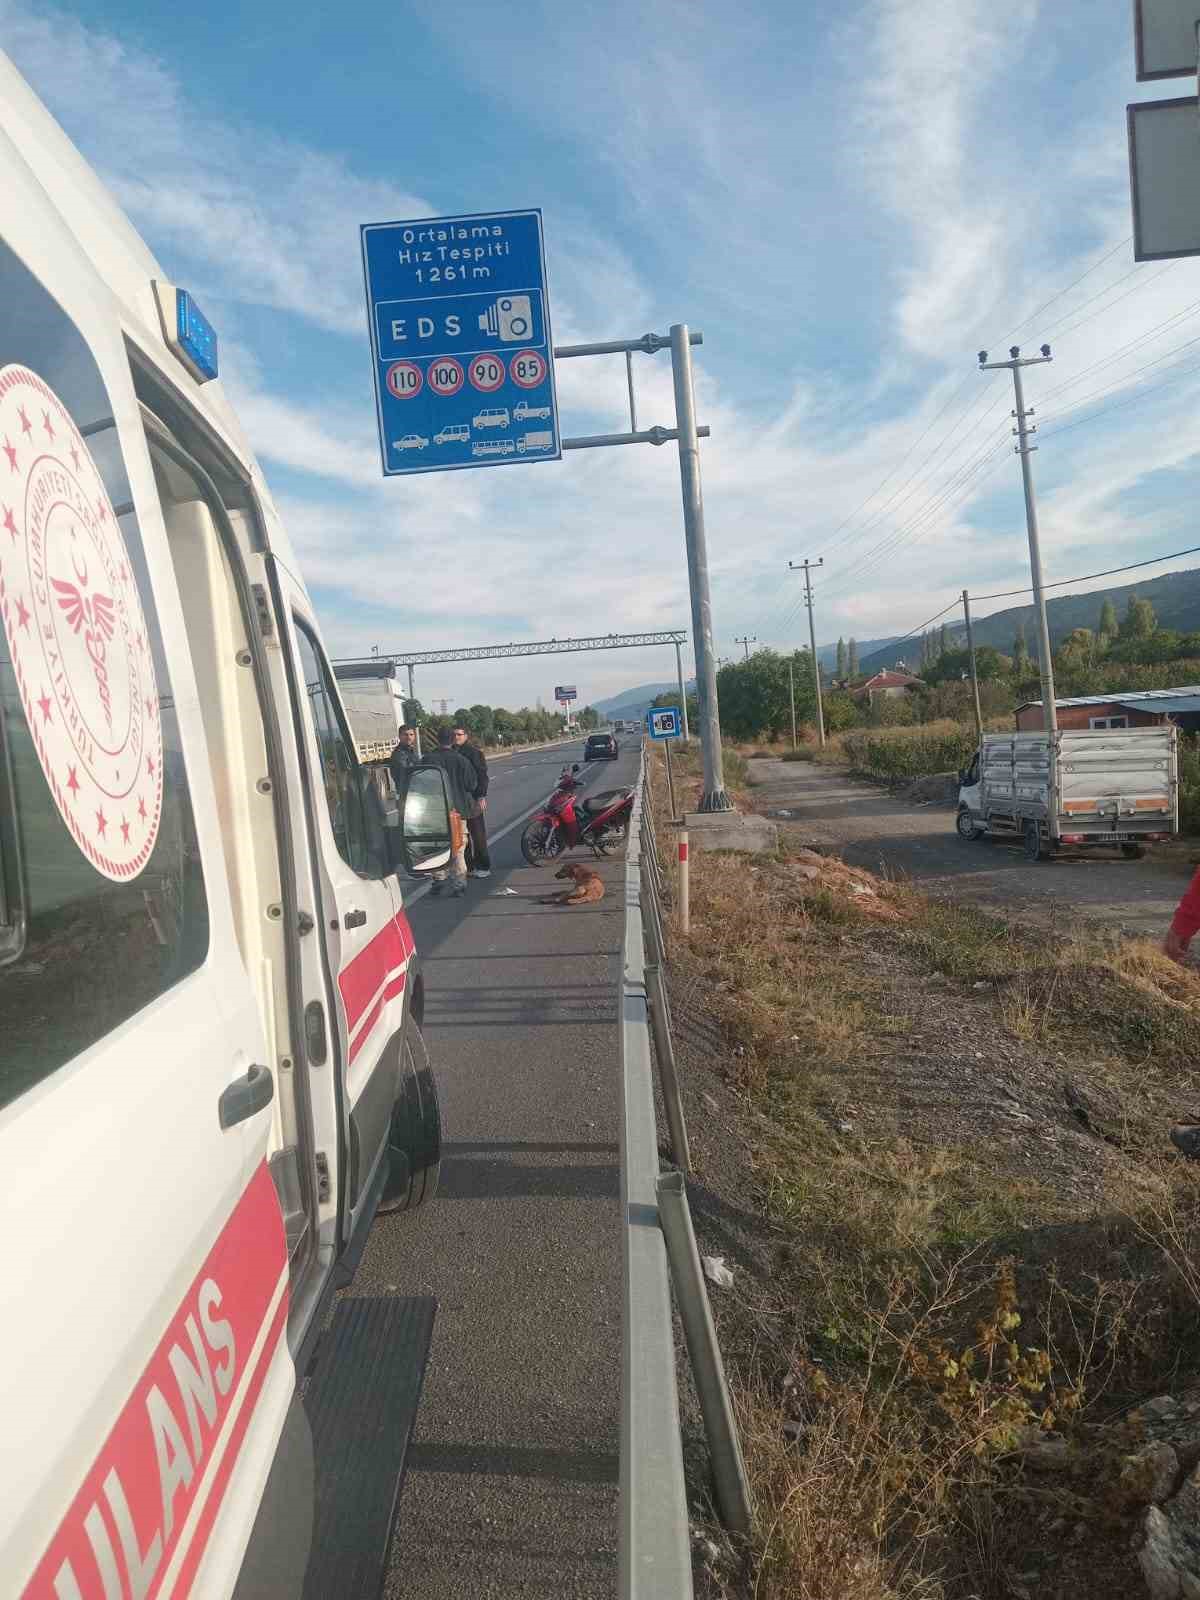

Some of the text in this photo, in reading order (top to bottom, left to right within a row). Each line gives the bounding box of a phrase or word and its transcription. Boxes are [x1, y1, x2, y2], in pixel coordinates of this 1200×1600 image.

[402, 225, 503, 244] Ortalama
[437, 241, 511, 262] Tespiti
[393, 360, 539, 389] 110 100 90 85
